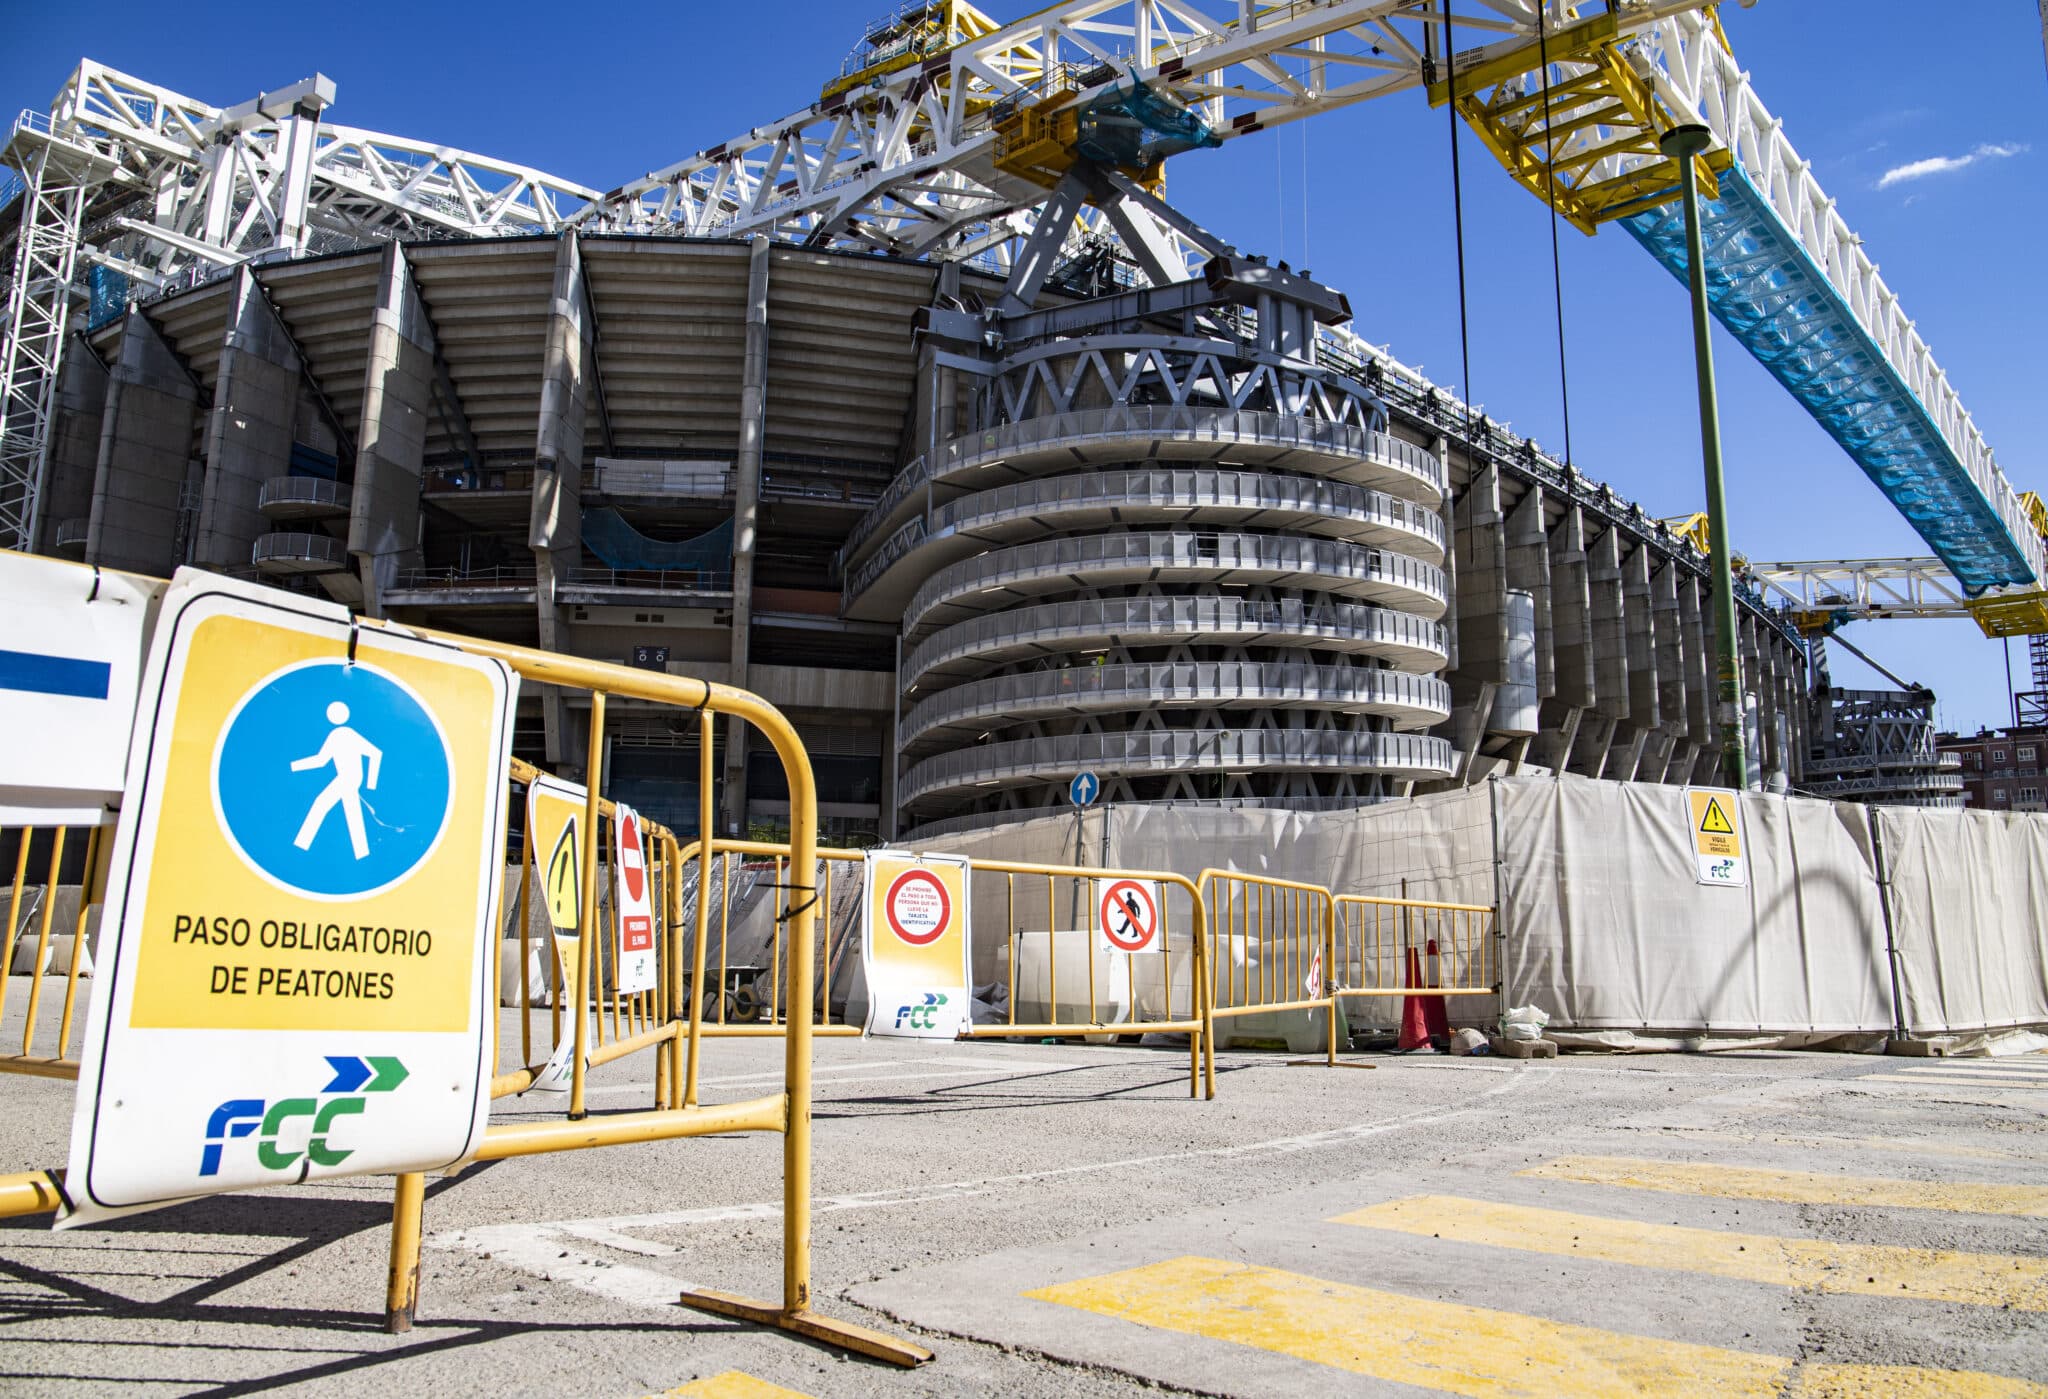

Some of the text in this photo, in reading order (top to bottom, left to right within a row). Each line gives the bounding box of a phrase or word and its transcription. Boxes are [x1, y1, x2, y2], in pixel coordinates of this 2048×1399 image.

[1711, 865, 1730, 878] FCC
[173, 915, 432, 956] PASO OBLIGATORIO
[210, 966, 394, 1000] DE PEATONES
[895, 1005, 938, 1029] FCC
[198, 1097, 366, 1177] FCC
